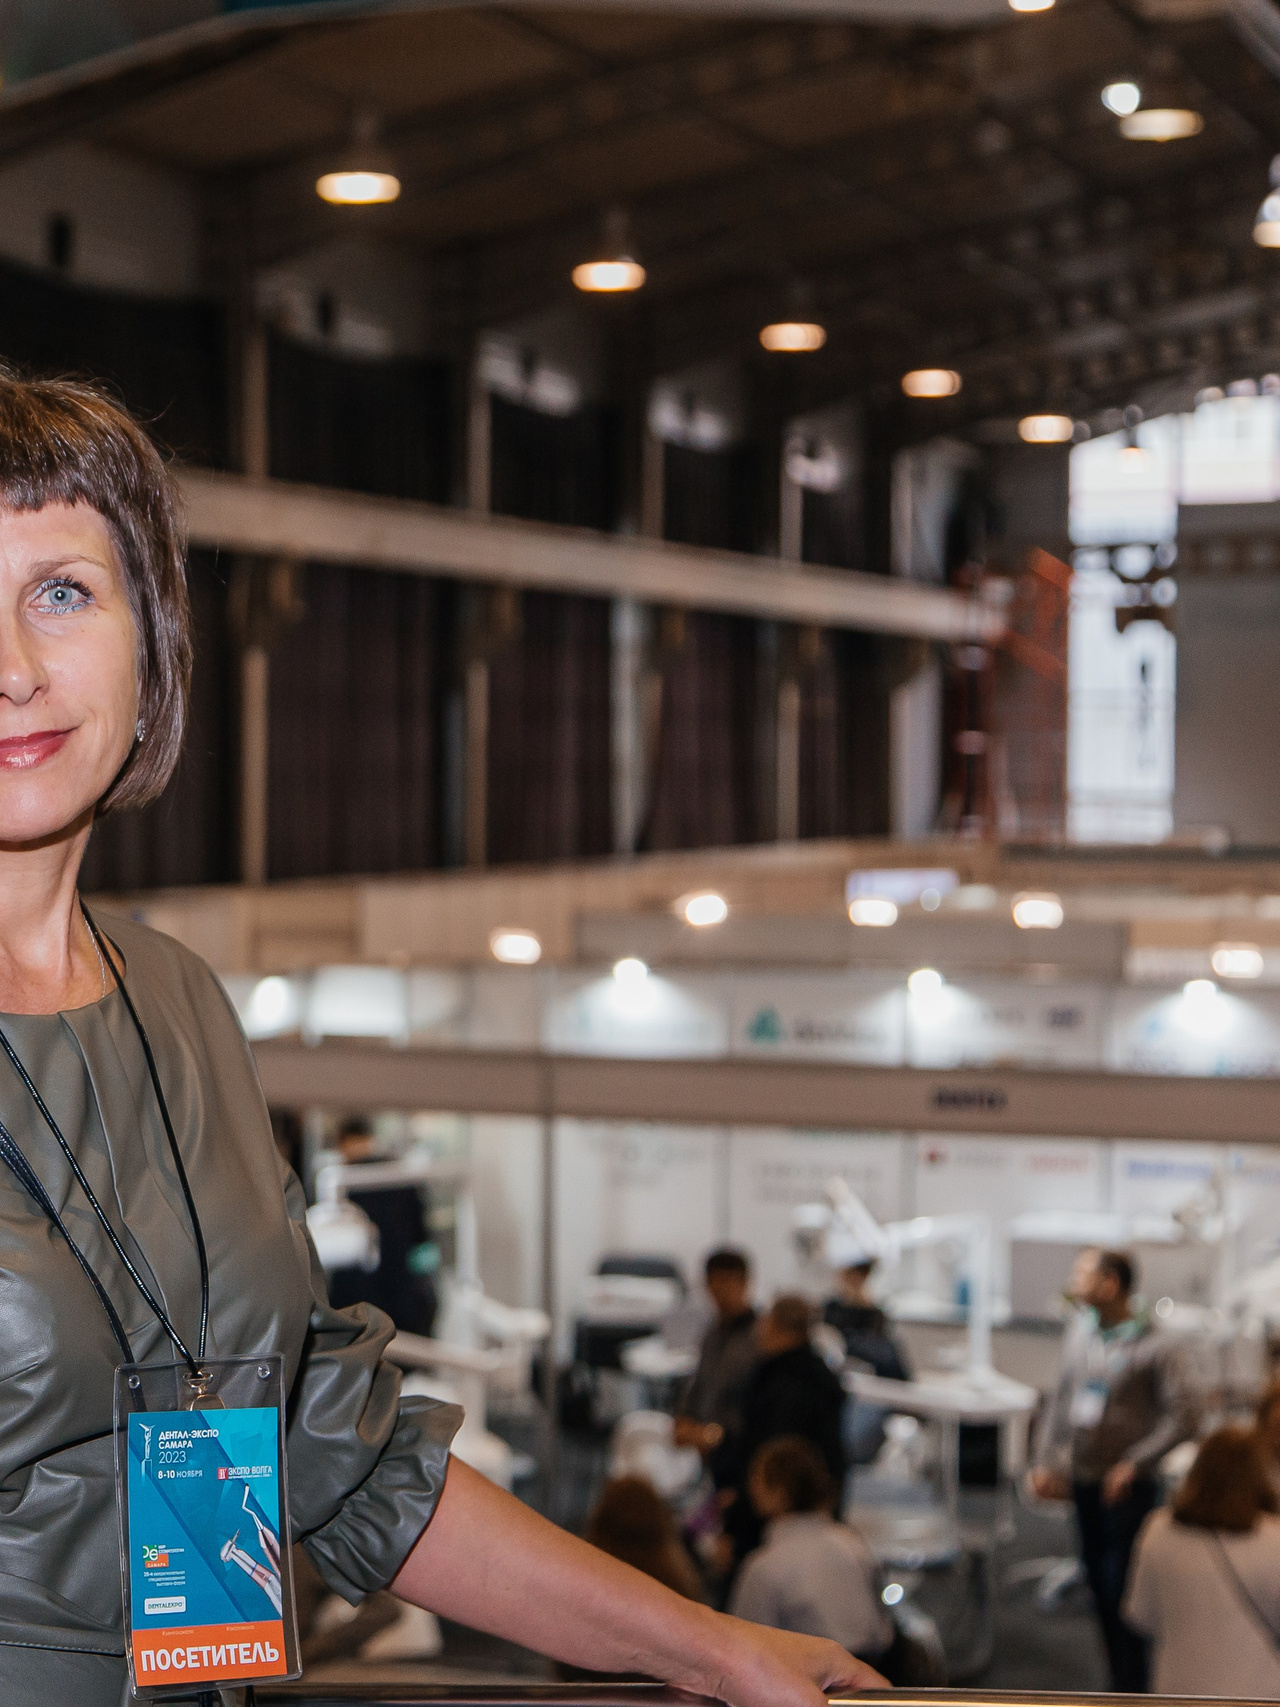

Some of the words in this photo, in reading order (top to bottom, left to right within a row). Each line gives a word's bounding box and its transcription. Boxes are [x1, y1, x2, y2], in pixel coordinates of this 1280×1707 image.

[158, 1429, 219, 1441] ДЕНТАЛ-ЭКСПО
[158, 1440, 193, 1449] САМАРА
[158, 1450, 186, 1464] 2023
[157, 1470, 175, 1479] 8-10
[176, 1470, 203, 1478] НОЯБРЯ
[140, 1641, 280, 1672] ПОСЕТИТЕЛЬ
